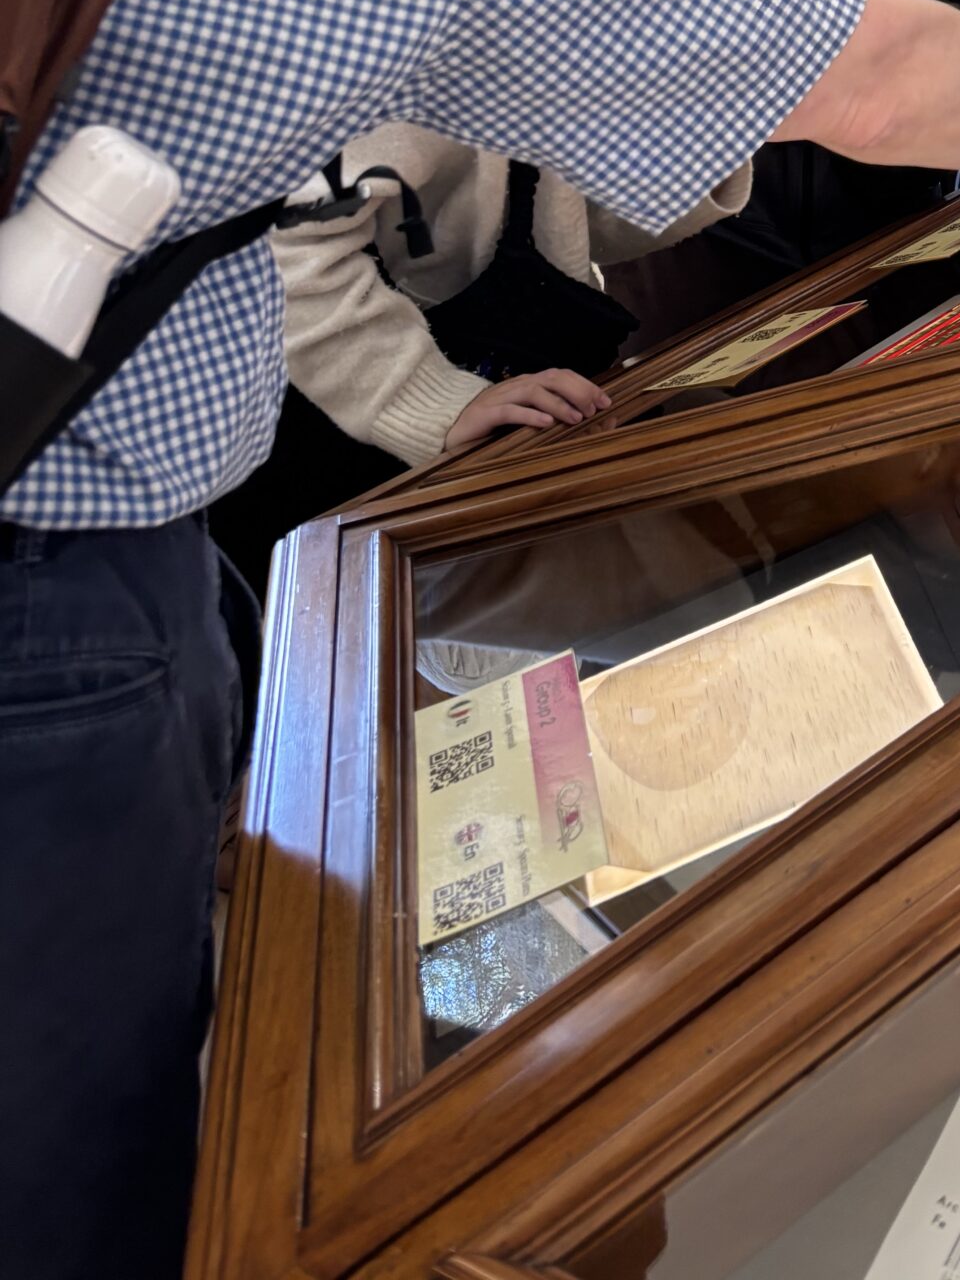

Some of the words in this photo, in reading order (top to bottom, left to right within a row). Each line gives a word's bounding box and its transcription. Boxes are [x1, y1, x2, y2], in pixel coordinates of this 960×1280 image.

[535, 681, 552, 718] Group
[540, 717, 556, 728] 2
[464, 842, 479, 861] En
[936, 1195, 959, 1214] Arc
[931, 1213, 947, 1229] Fe
